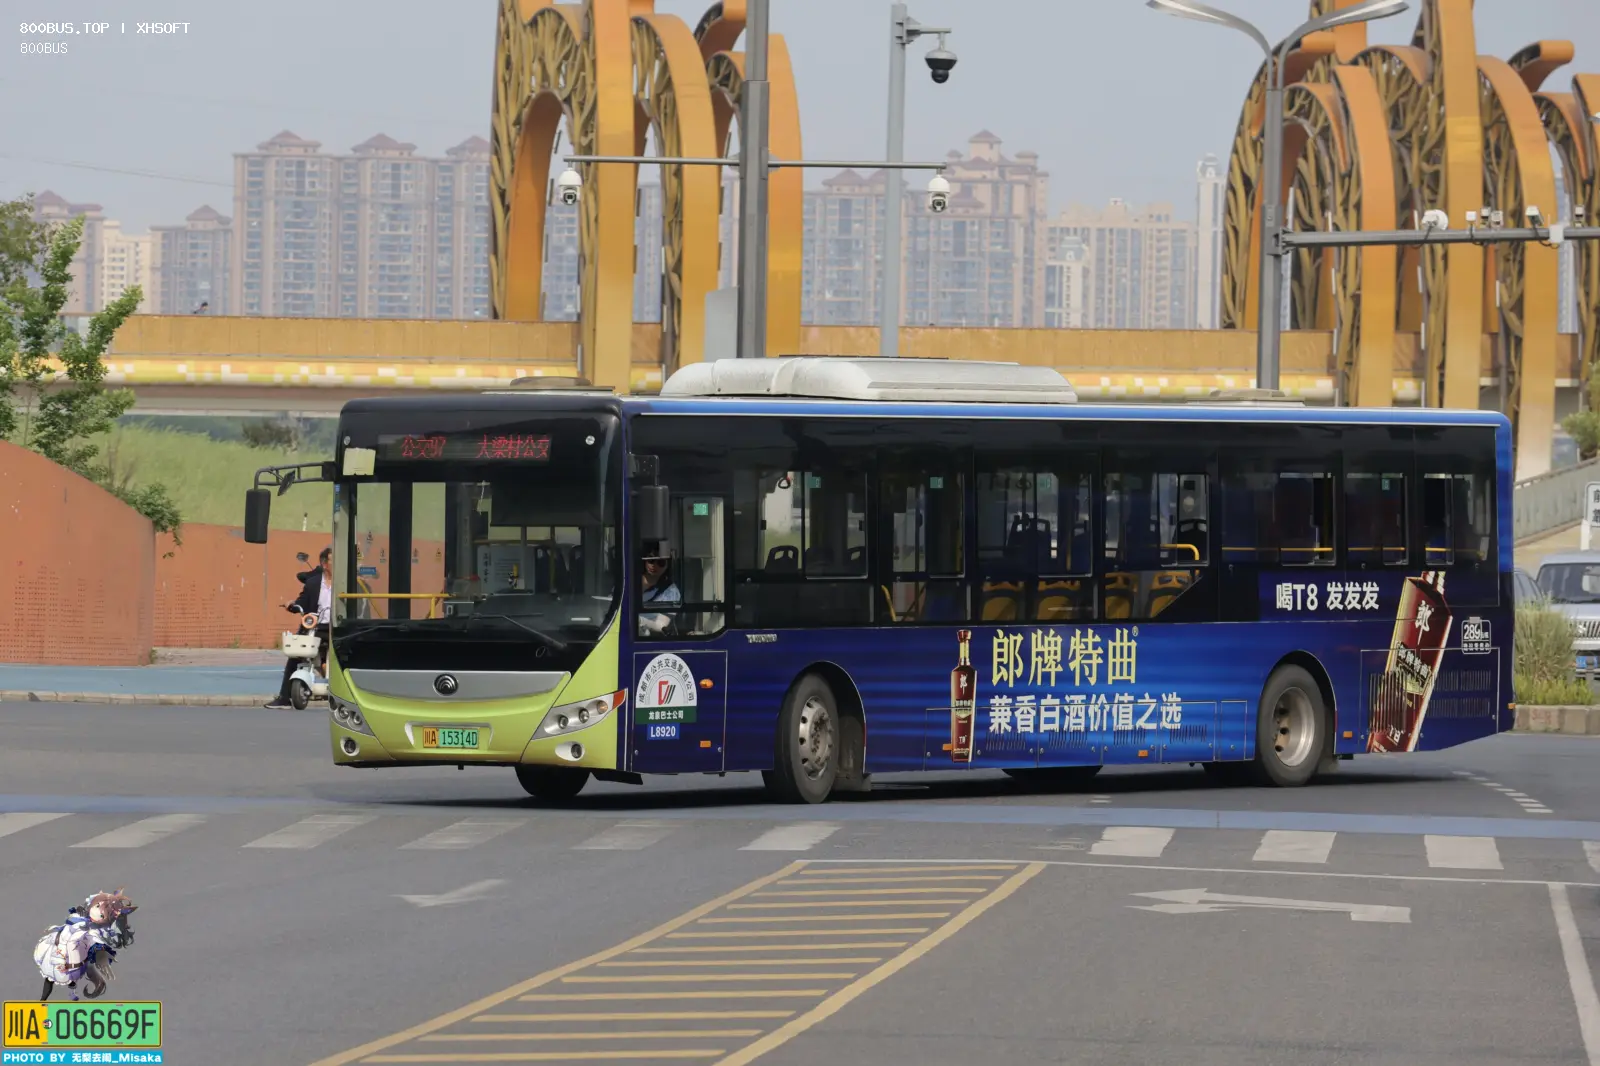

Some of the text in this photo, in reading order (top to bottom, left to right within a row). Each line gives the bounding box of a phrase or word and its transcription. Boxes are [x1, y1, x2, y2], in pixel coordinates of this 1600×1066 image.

[1275, 581, 1380, 611] 喝T8 发发发
[991, 628, 1138, 688] 郎牌特曲
[989, 691, 1182, 735] 兼香白酒价值之选
[650, 726, 676, 738] L8920
